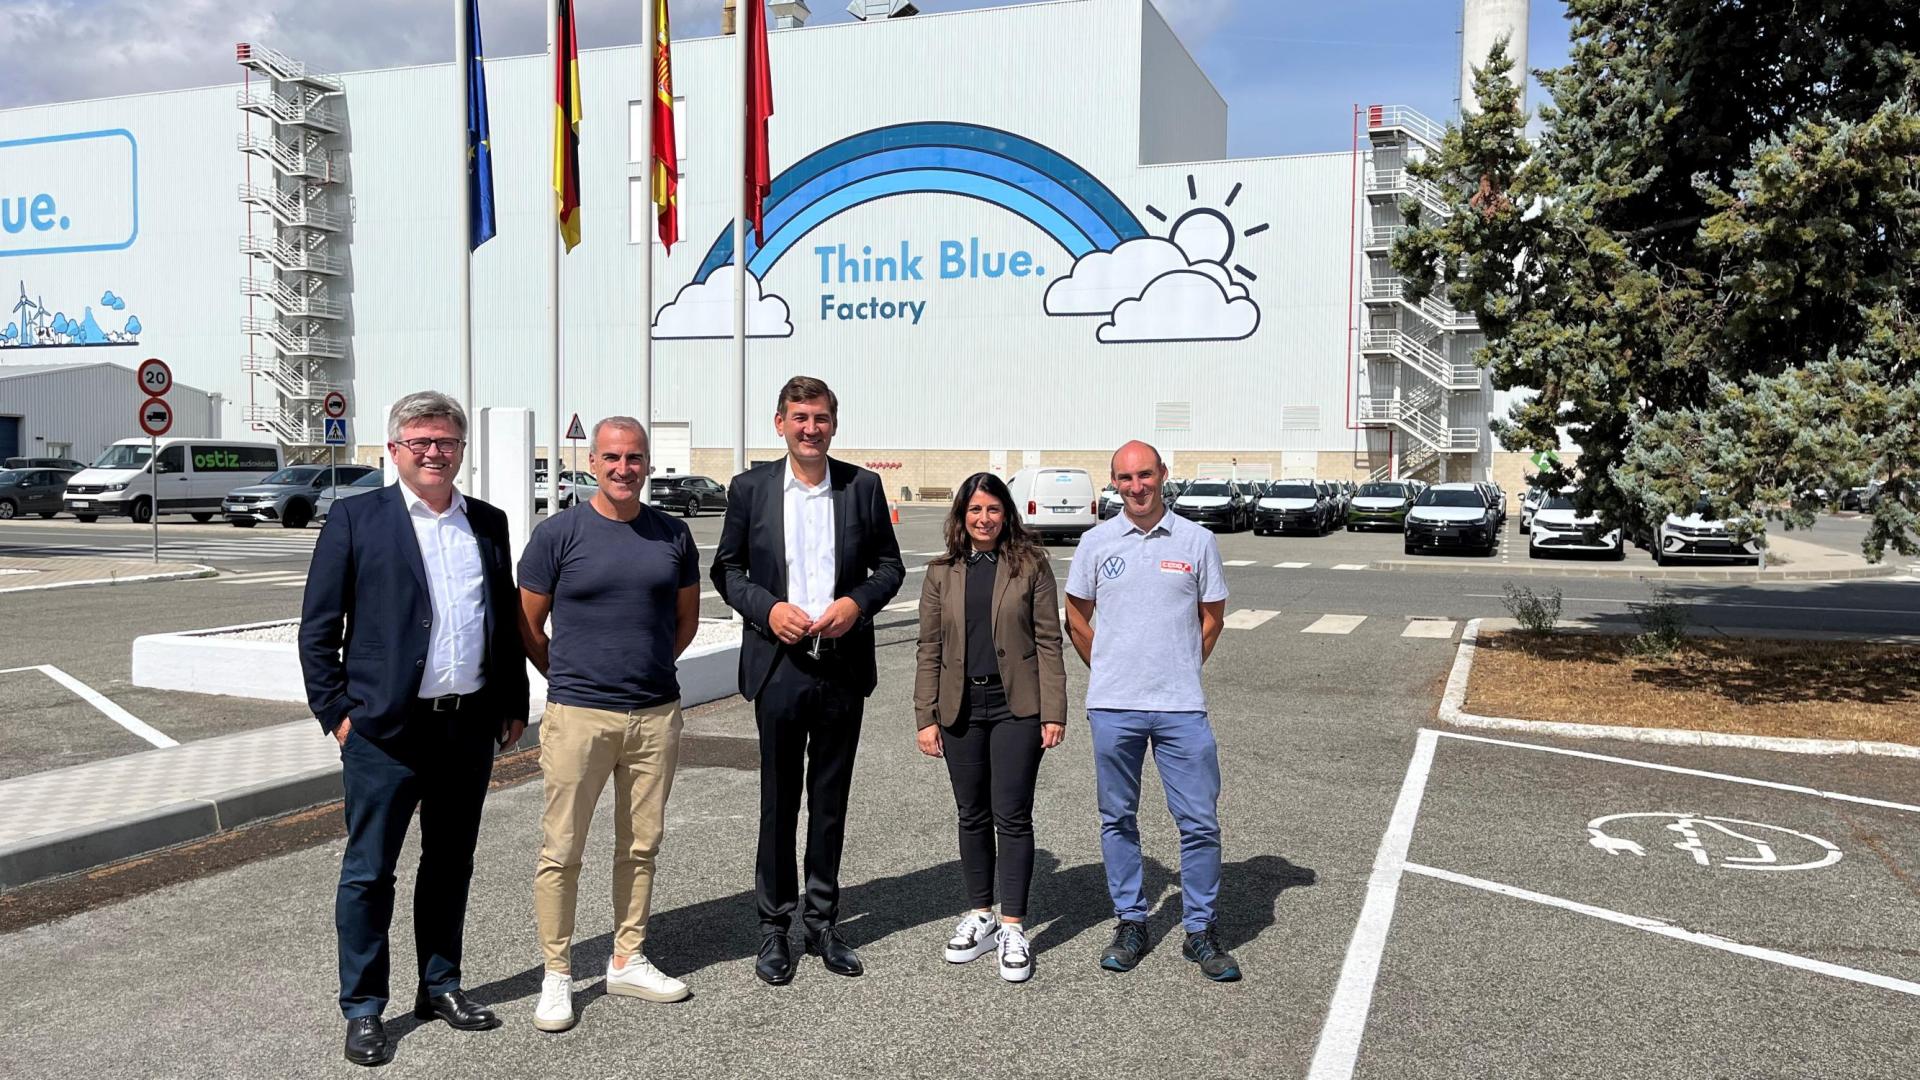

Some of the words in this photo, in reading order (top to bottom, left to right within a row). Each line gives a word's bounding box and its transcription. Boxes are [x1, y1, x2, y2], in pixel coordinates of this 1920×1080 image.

[814, 240, 924, 284] Think
[939, 237, 1045, 280] Blue.
[820, 294, 927, 325] Factory
[145, 371, 166, 385] 20
[194, 450, 240, 468] ostiz
